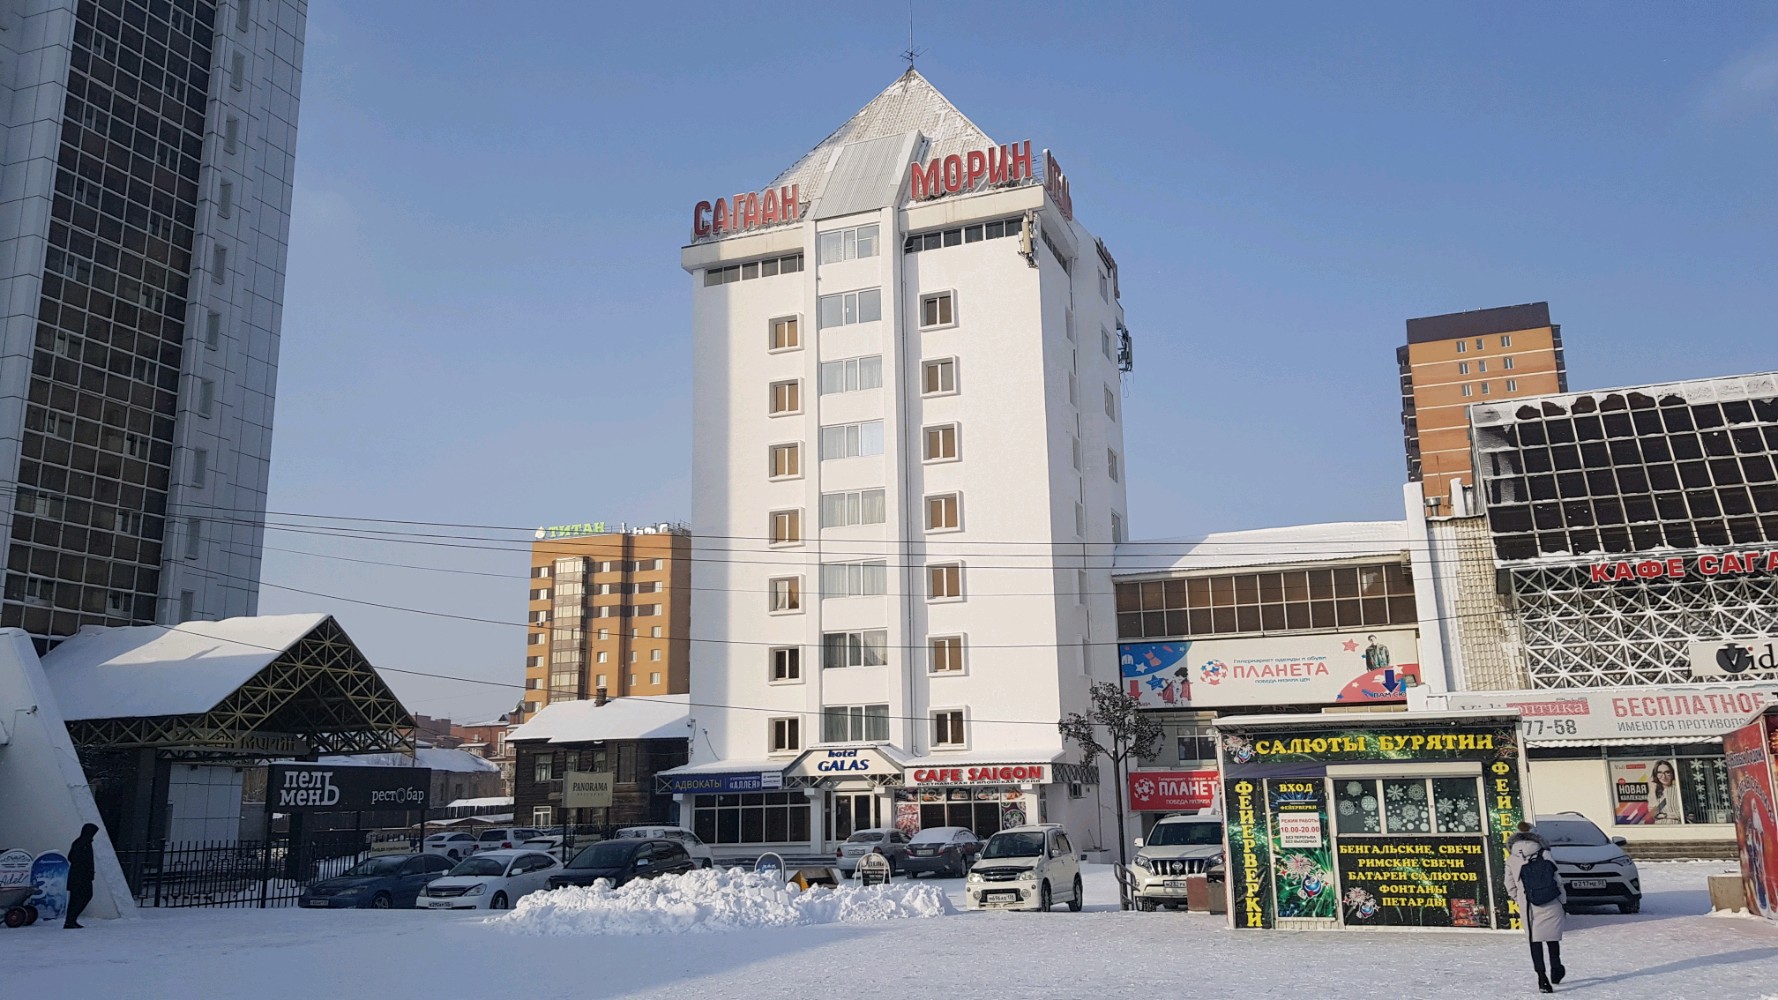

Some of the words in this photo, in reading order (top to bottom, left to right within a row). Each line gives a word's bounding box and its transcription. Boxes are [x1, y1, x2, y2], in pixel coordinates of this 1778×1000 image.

[694, 184, 799, 236] САГААН
[911, 139, 1032, 200] МОРИН
[548, 521, 605, 538] ТИТАН
[1590, 556, 1686, 583] КАФЕ
[1233, 662, 1329, 678] ПЛАНЕТА
[1618, 721, 1674, 732] ИМЕЮТСЯ
[1678, 717, 1749, 729] ПРОТИВОП
[1255, 736, 1366, 755] САЛЮТЫ
[1378, 734, 1494, 751] БУРЯТИИ
[828, 749, 858, 758] hotel
[818, 759, 870, 772] GALAS
[913, 769, 964, 783] CAFE
[967, 766, 1044, 781] SAIGON
[572, 782, 608, 792] PANORAMA
[674, 779, 722, 791] АДВОКАТЫ
[1158, 781, 1218, 797] ПЛАНЕТ
[1279, 783, 1314, 793] ВХОД
[1619, 785, 1647, 795] НОВАЯ
[1438, 845, 1482, 854] СВЕЧИ
[1358, 859, 1419, 868] РИМСКИЕ
[1422, 859, 1464, 868] СВЕЧИ
[1348, 871, 1407, 881] БАТАРЕИ
[1411, 871, 1478, 881] САЛЮТОВ
[1379, 885, 1448, 894] ФОНТАНЫ
[1382, 897, 1447, 907] ПЕТАРДЫ
